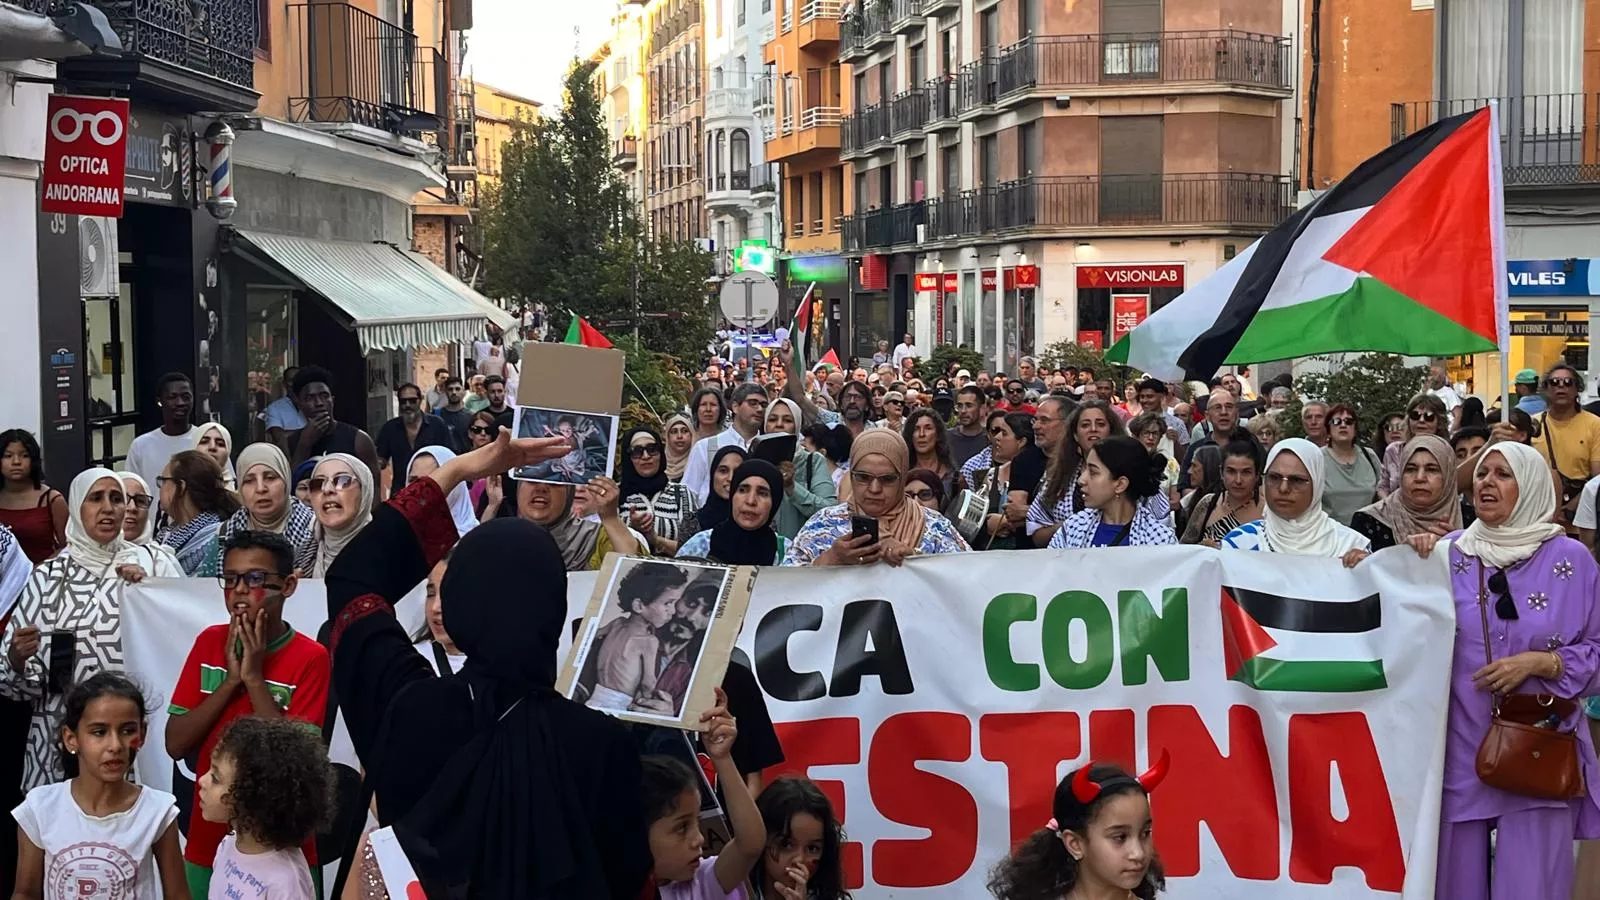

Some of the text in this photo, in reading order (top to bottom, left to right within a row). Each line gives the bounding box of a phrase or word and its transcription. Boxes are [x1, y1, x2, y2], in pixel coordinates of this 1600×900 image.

[60, 155, 109, 175] OPTICA
[45, 183, 120, 205] ANDORRANA
[1104, 270, 1177, 282] VISIONLAB
[1508, 272, 1565, 285] VILES
[1116, 318, 1137, 326] RE
[733, 587, 1190, 702] CA CON
